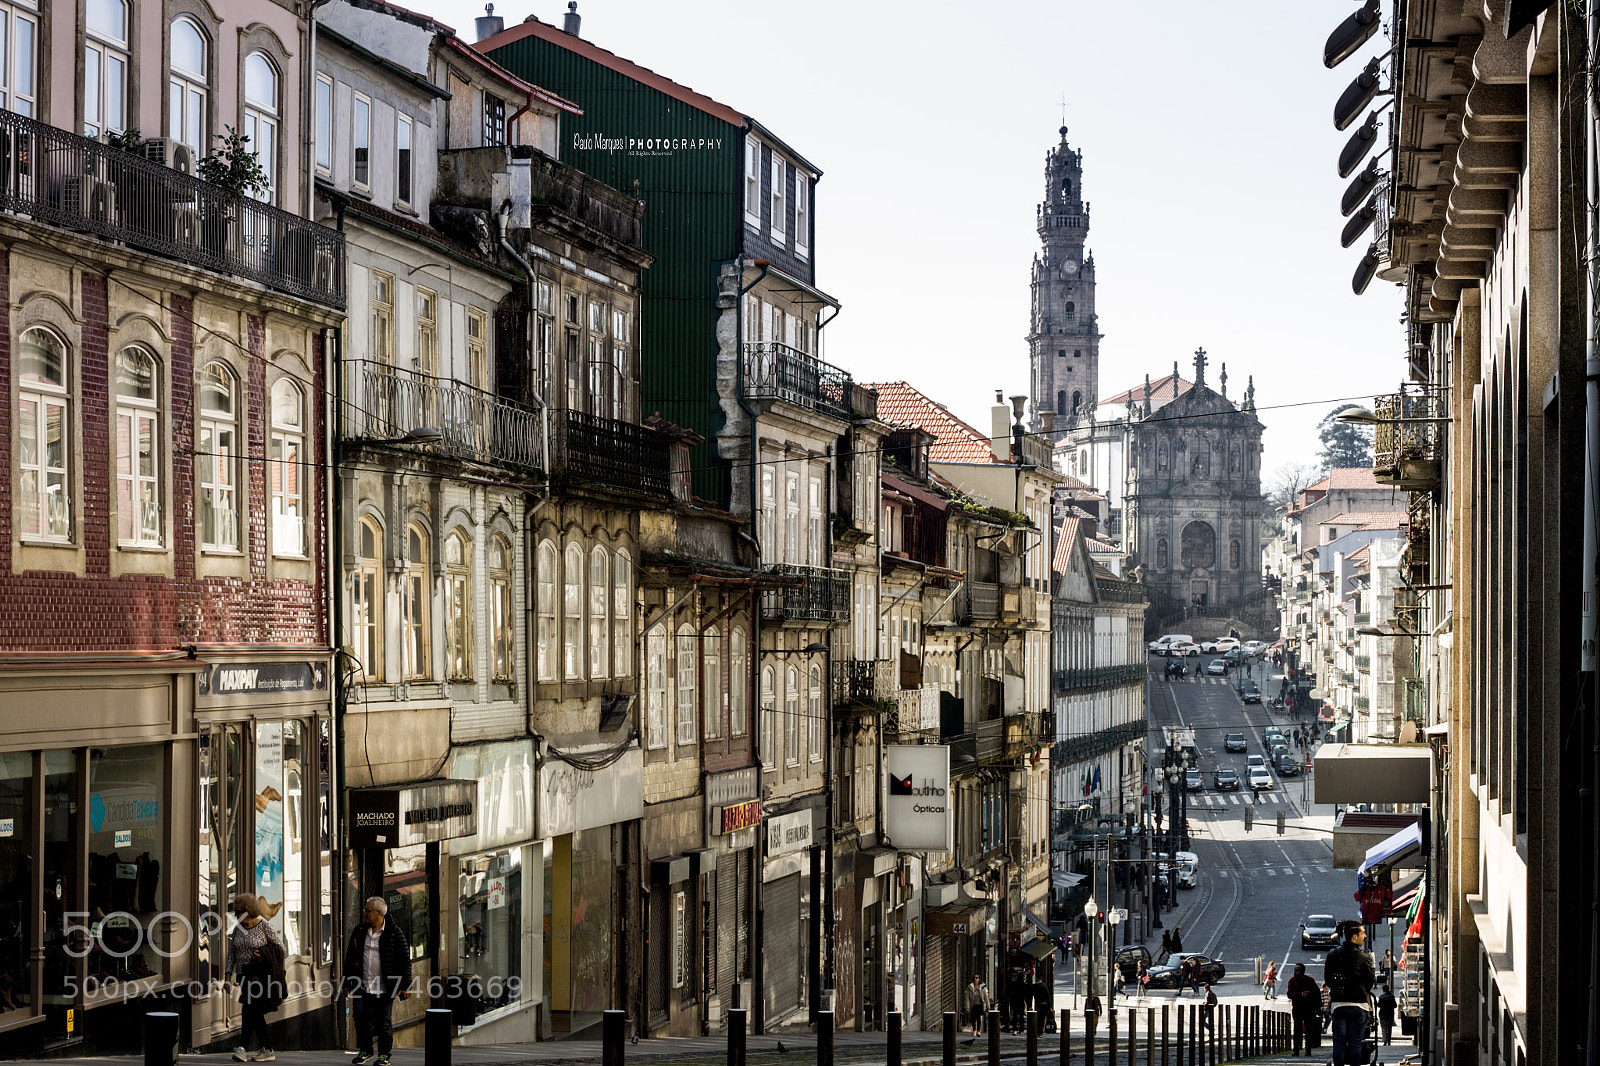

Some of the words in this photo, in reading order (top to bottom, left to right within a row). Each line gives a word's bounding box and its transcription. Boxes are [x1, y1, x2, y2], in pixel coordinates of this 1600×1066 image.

[220, 670, 258, 690] MAXPAY
[913, 803, 945, 814] Ópticas
[357, 812, 395, 820] MACHADO
[356, 819, 395, 827] JOALHEIRO
[115, 834, 131, 843] SALDOS
[953, 923, 966, 933] 44
